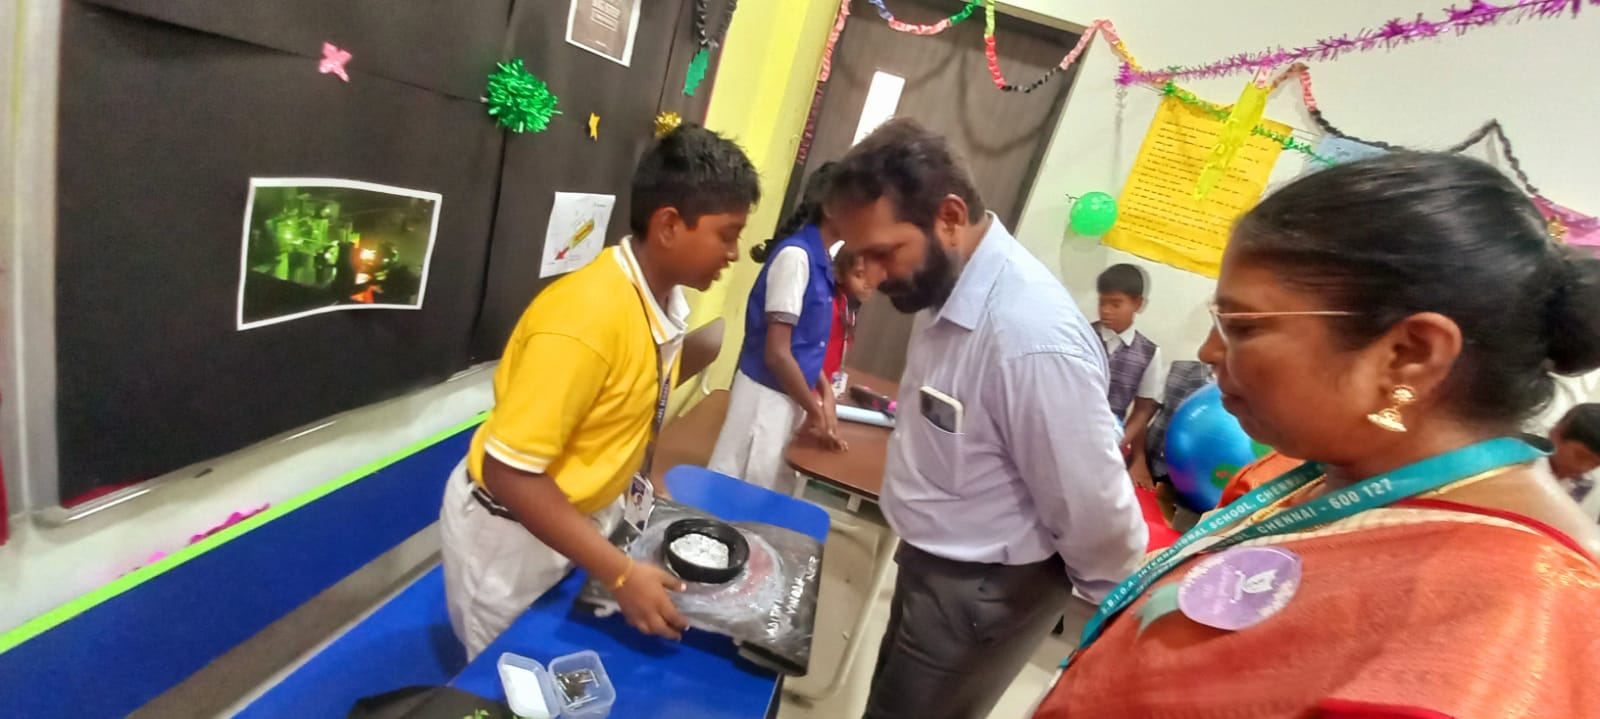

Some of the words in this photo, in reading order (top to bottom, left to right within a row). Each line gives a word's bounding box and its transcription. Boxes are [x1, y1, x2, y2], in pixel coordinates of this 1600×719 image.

[1256, 474, 1306, 503] CHENN
[1257, 507, 1317, 534] CHENNAI
[1328, 490, 1360, 510] 600
[1362, 478, 1393, 498] 127
